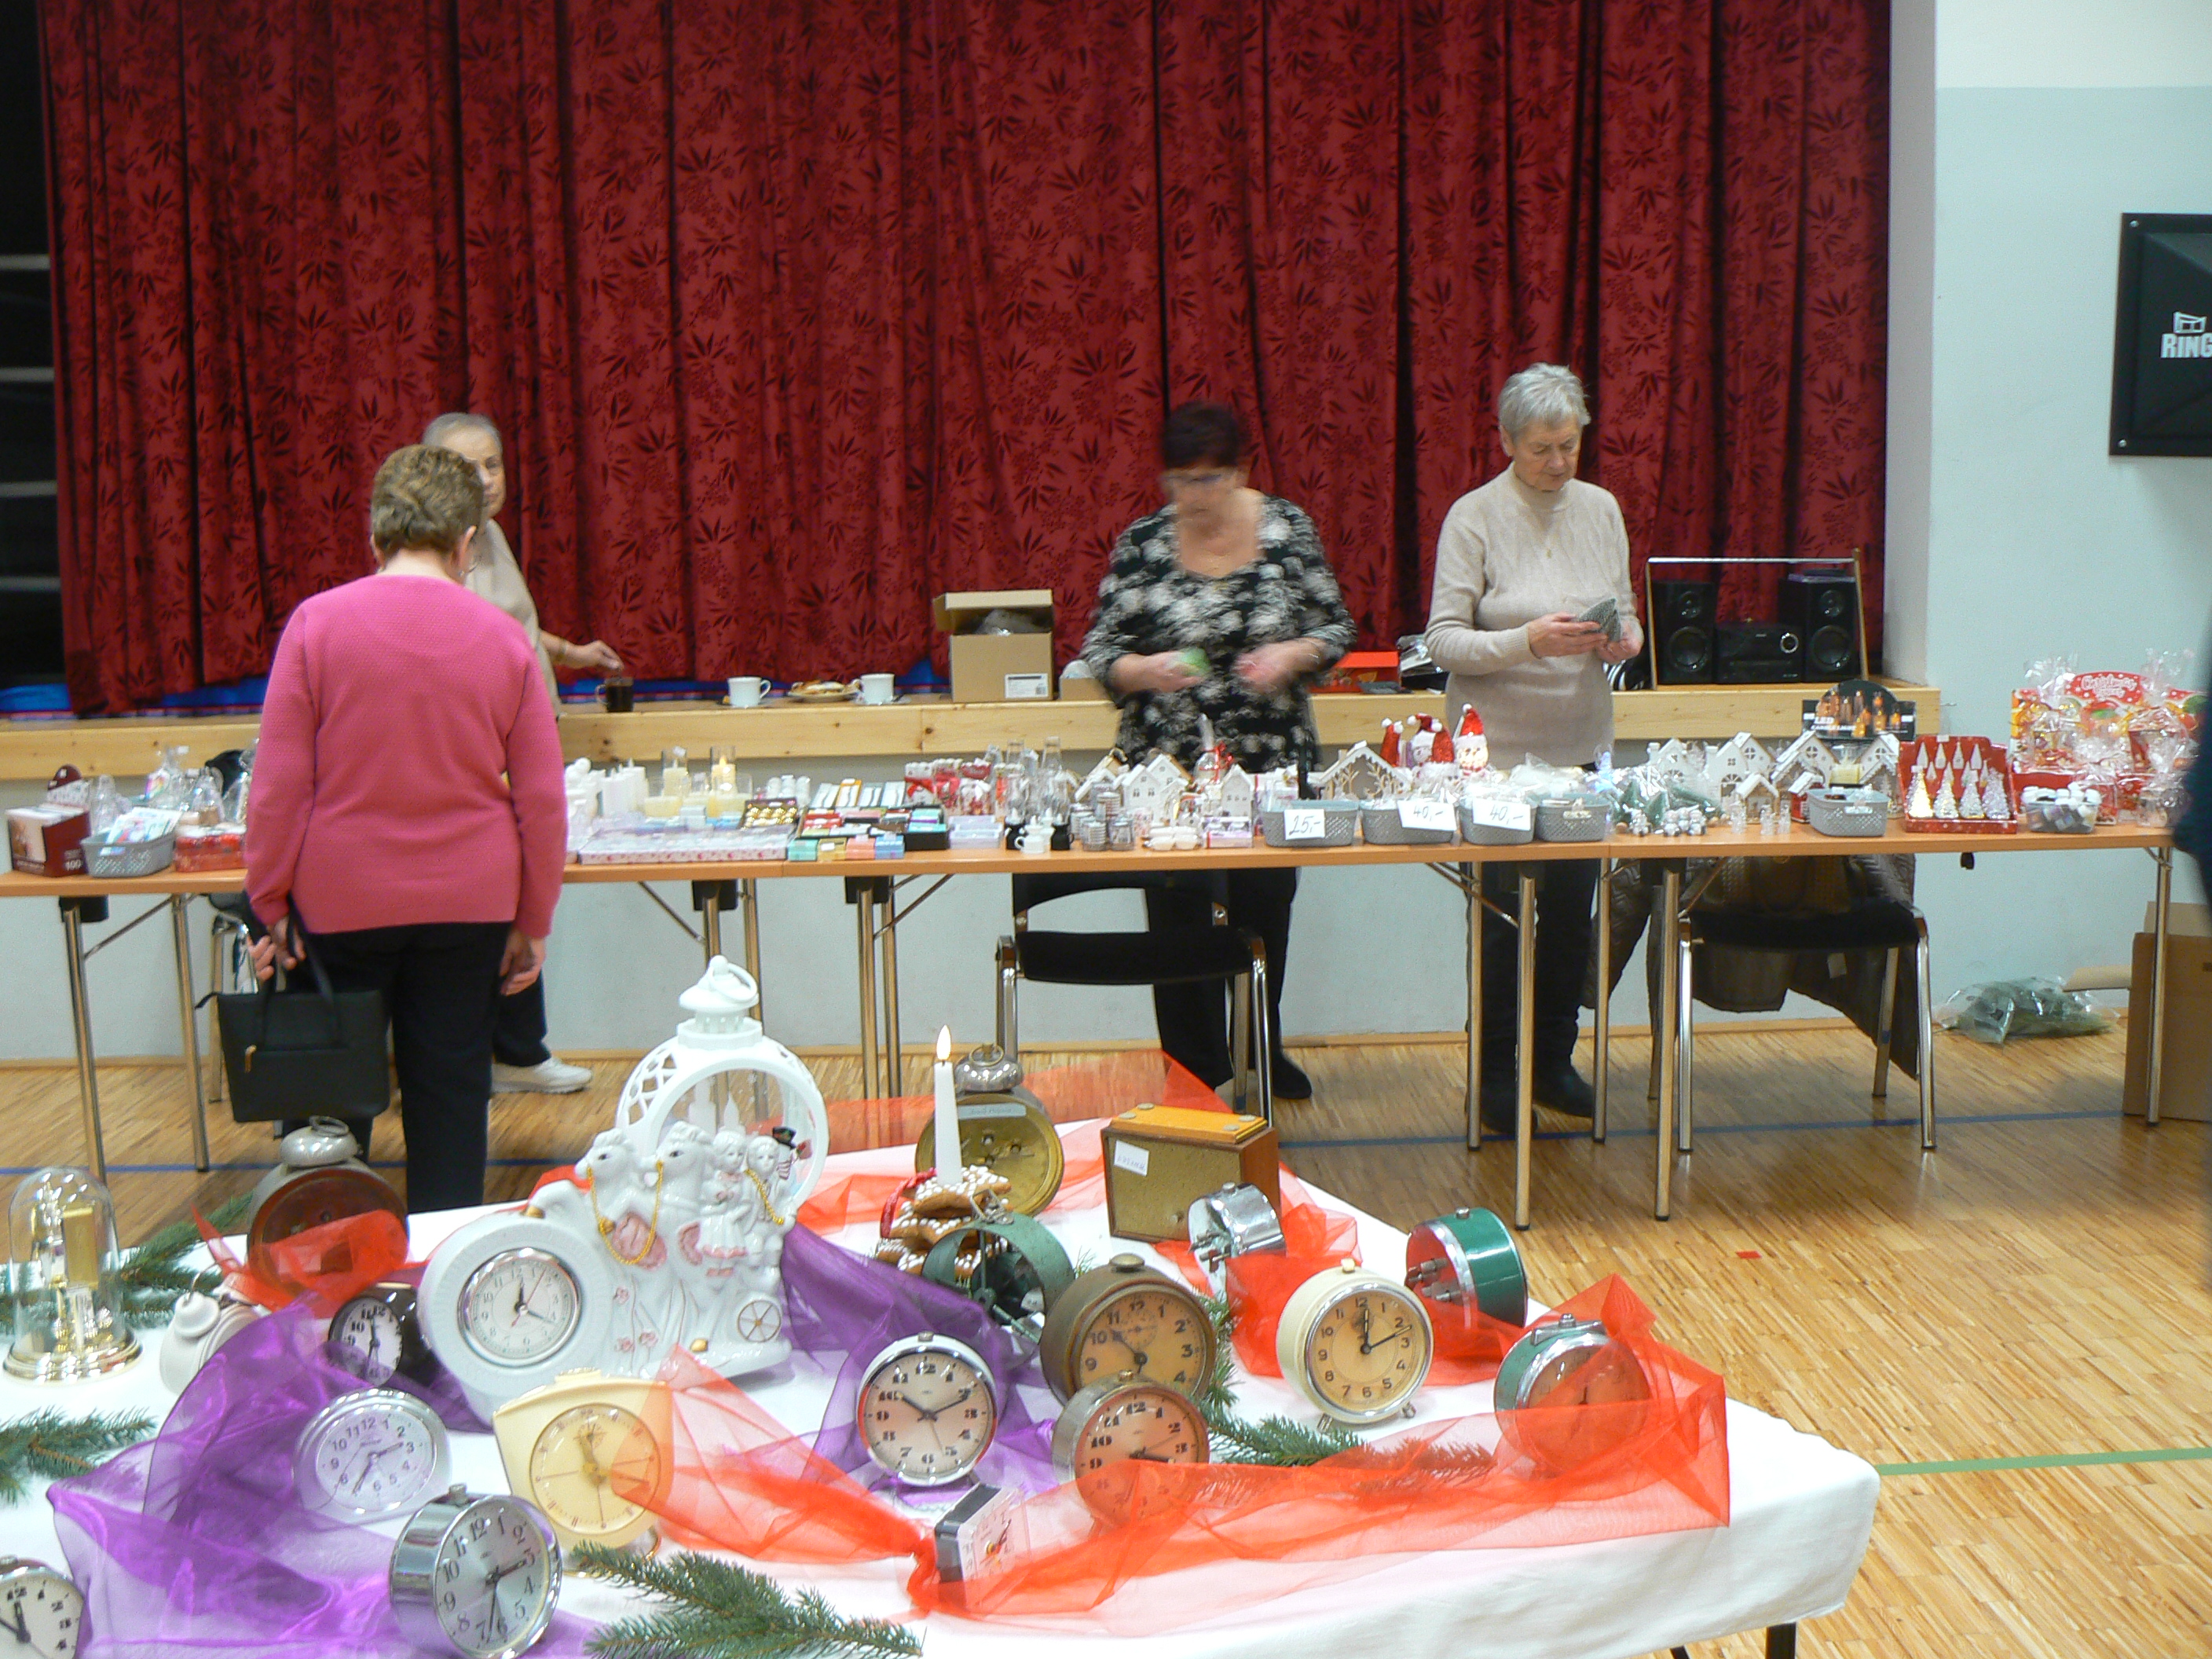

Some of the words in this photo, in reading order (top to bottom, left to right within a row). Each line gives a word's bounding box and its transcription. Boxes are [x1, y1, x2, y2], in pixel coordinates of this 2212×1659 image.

[1413, 805, 1443, 821] 40,-
[1489, 804, 1523, 824] 40,-
[1356, 1298, 1367, 1307] 12
[1108, 1311, 1119, 1324] 11
[1336, 1309, 1343, 1319] 11
[352, 1321, 364, 1332] 10
[1175, 1320, 1186, 1334] 2
[1395, 1317, 1403, 1328] 2
[1092, 1331, 1108, 1344] 10
[1321, 1327, 1333, 1338] 10
[1401, 1337, 1410, 1348] 3
[1181, 1344, 1193, 1358] 3
[1318, 1349, 1328, 1361] 9
[915, 1364, 936, 1374] 12
[1086, 1358, 1097, 1371] 9
[1397, 1360, 1405, 1370] 4
[1174, 1371, 1185, 1382] 4
[1325, 1371, 1334, 1382] 8
[1382, 1378, 1392, 1390] 5
[1342, 1386, 1351, 1397] 7
[1363, 1386, 1372, 1397] 6
[1126, 1401, 1145, 1415] 12
[361, 1417, 375, 1430] 12
[383, 1419, 389, 1430] 1
[1168, 1422, 1181, 1434] 2
[346, 1425, 360, 1437] 11
[397, 1426, 405, 1437] 2
[332, 1438, 347, 1451] 10
[407, 1441, 415, 1453] 3
[1092, 1436, 1112, 1448] 10
[900, 1447, 913, 1457] 7
[331, 1458, 339, 1469] 9
[402, 1460, 409, 1470] 4
[374, 1480, 381, 1491] 6
[471, 1518, 487, 1541] 12
[498, 1516, 504, 1534] 1
[514, 1525, 526, 1544] 2
[454, 1536, 466, 1557] 11
[444, 1560, 460, 1583] 10
[524, 1577, 533, 1595] 4
[51, 1601, 64, 1612] 2
[444, 1591, 456, 1611] 9
[515, 1599, 526, 1619] 5
[458, 1612, 470, 1631] 8
[476, 1620, 485, 1639] 7
